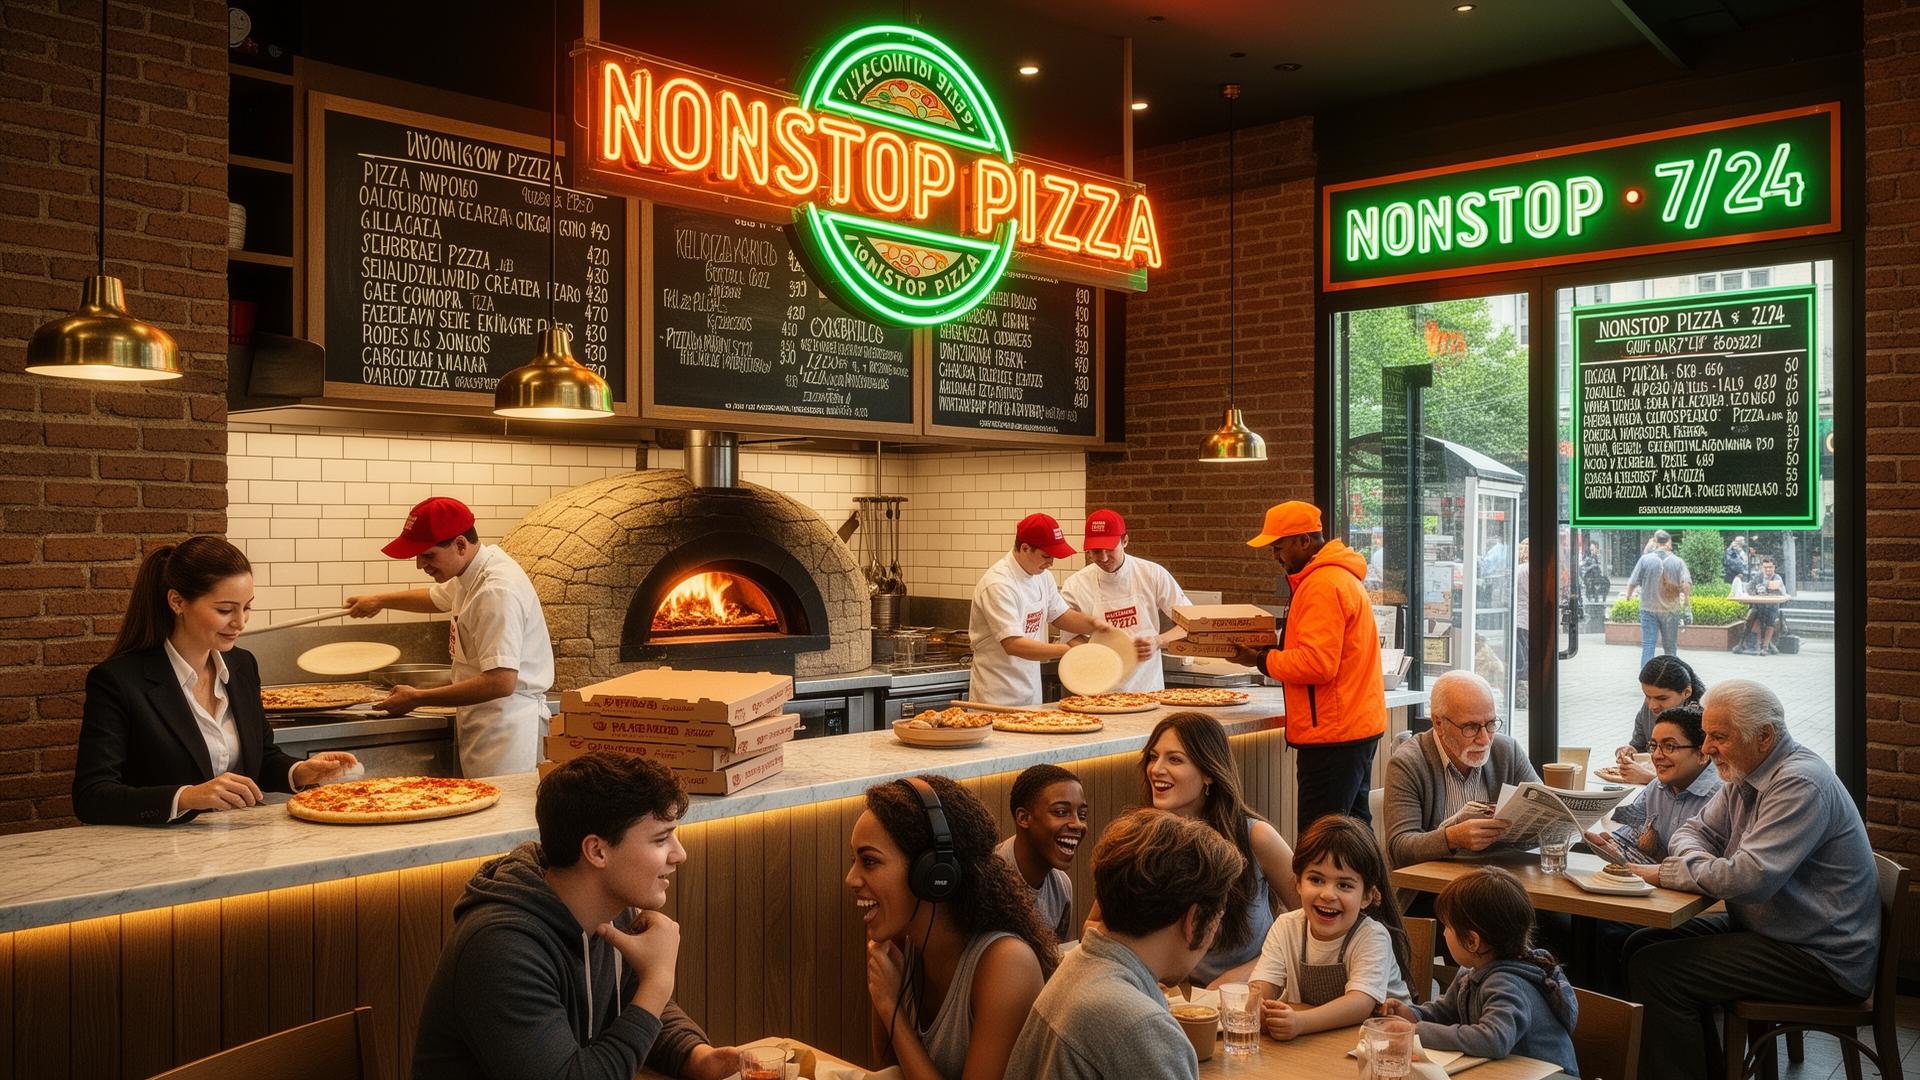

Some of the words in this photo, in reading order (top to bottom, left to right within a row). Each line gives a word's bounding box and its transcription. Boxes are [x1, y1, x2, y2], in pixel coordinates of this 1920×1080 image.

[364, 161, 410, 189] PIZZA
[603, 62, 955, 220] NONSTOP
[976, 158, 1162, 269] PIZZA
[1346, 175, 1603, 262] NONSTOP
[1655, 142, 1805, 230] 7/24
[934, 253, 980, 296] PIZZA
[584, 304, 608, 323] 470
[1599, 315, 1670, 339] NONSTOP
[1677, 309, 1724, 332] PIZZA
[1732, 407, 1764, 423] PIZZA
[1785, 483, 1799, 498] 50
